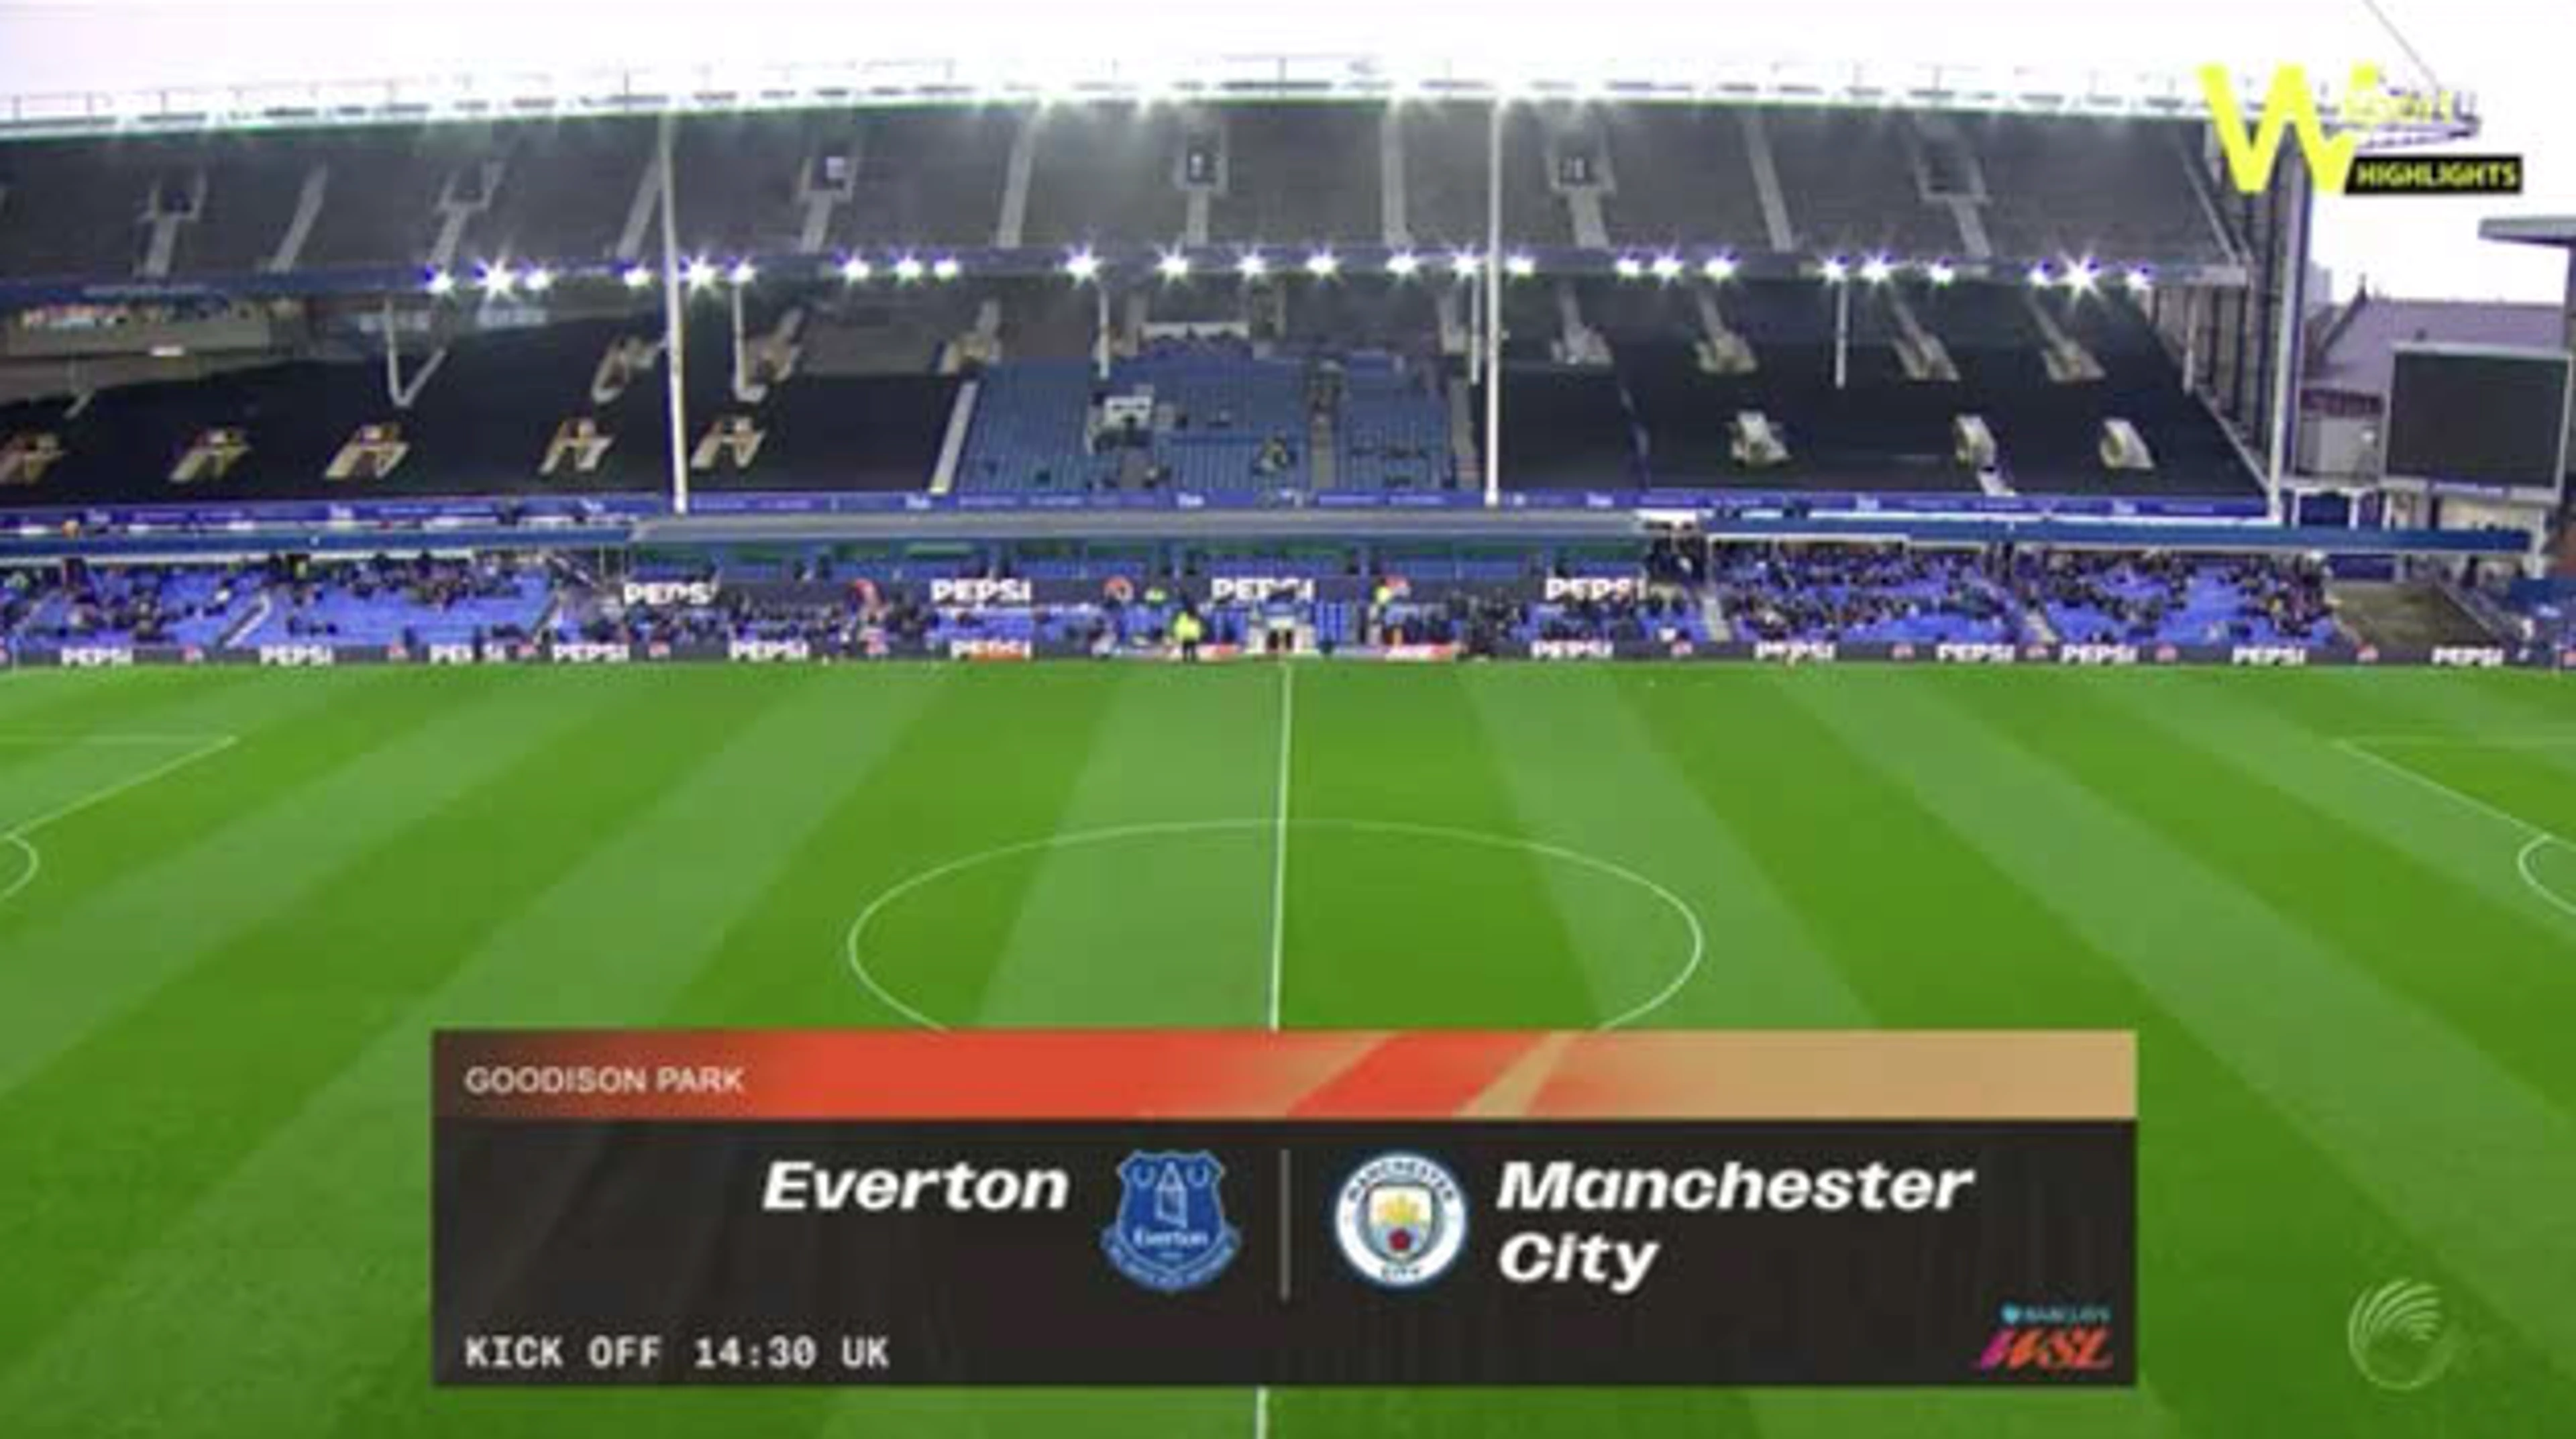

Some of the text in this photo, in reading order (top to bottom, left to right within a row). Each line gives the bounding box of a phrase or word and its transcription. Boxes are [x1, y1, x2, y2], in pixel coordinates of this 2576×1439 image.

[930, 578, 1031, 602] PEPSI
[61, 646, 133, 665] PEPSI
[260, 644, 334, 666] PEPSI
[552, 643, 629, 663] PEPSI
[729, 639, 808, 661] PEPSI
[1531, 639, 1613, 659] PEPSI
[1936, 643, 2015, 662] PEPSI
[2059, 644, 2137, 663] PEPSI
[2232, 646, 2306, 665] PEPSI
[2432, 647, 2504, 667] PEPSI
